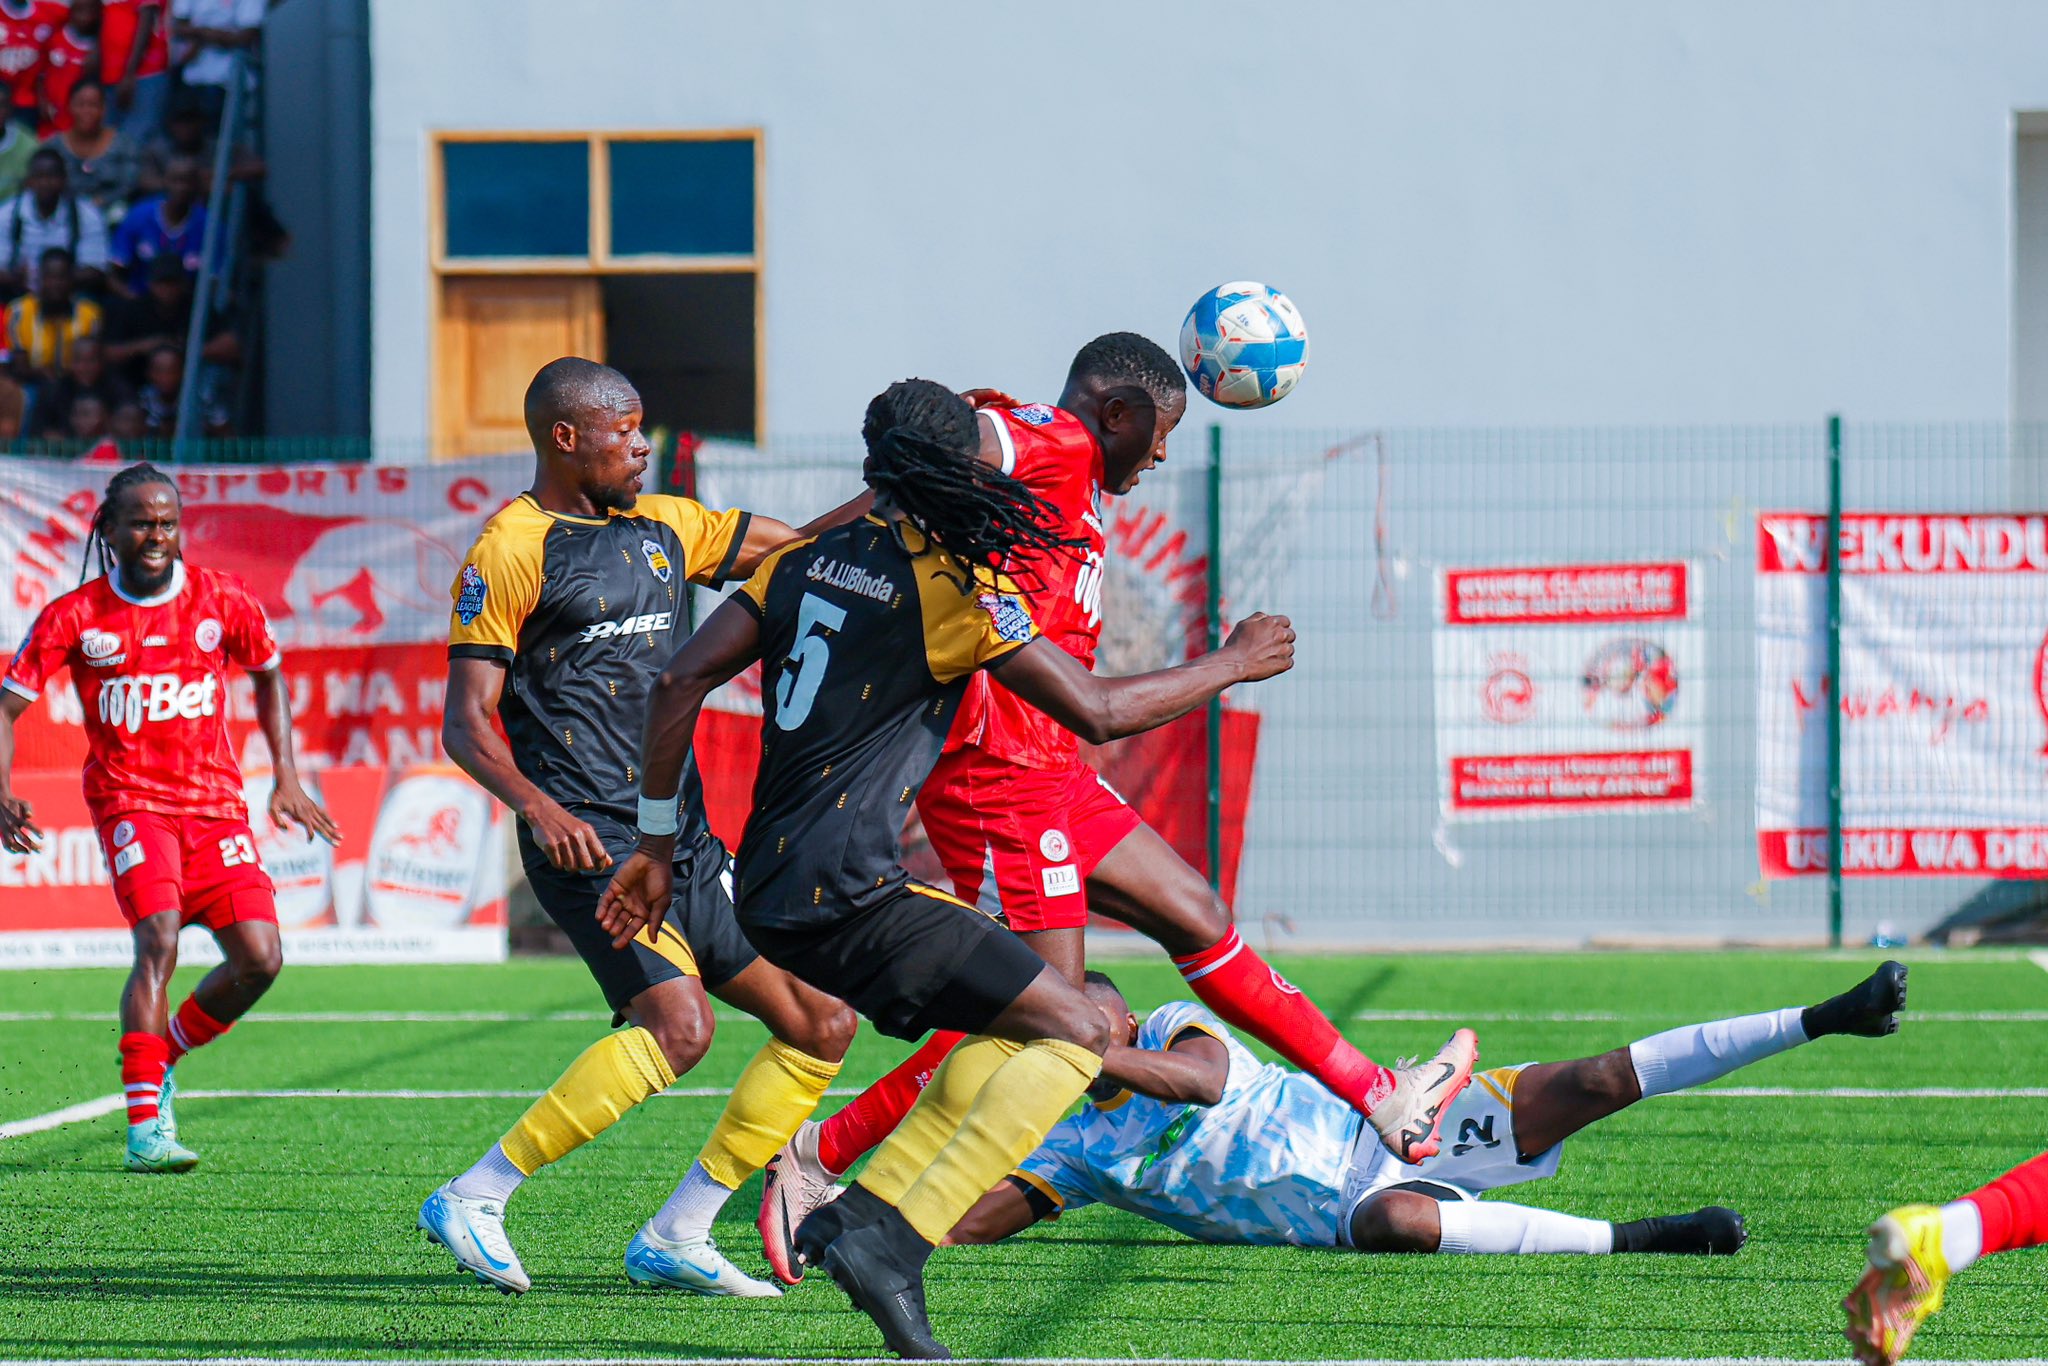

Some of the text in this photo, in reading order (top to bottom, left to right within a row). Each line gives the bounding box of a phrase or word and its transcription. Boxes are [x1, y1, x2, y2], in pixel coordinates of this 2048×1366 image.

[177, 466, 407, 501] SPORTS
[775, 592, 848, 731] 5
[218, 833, 257, 868] 23
